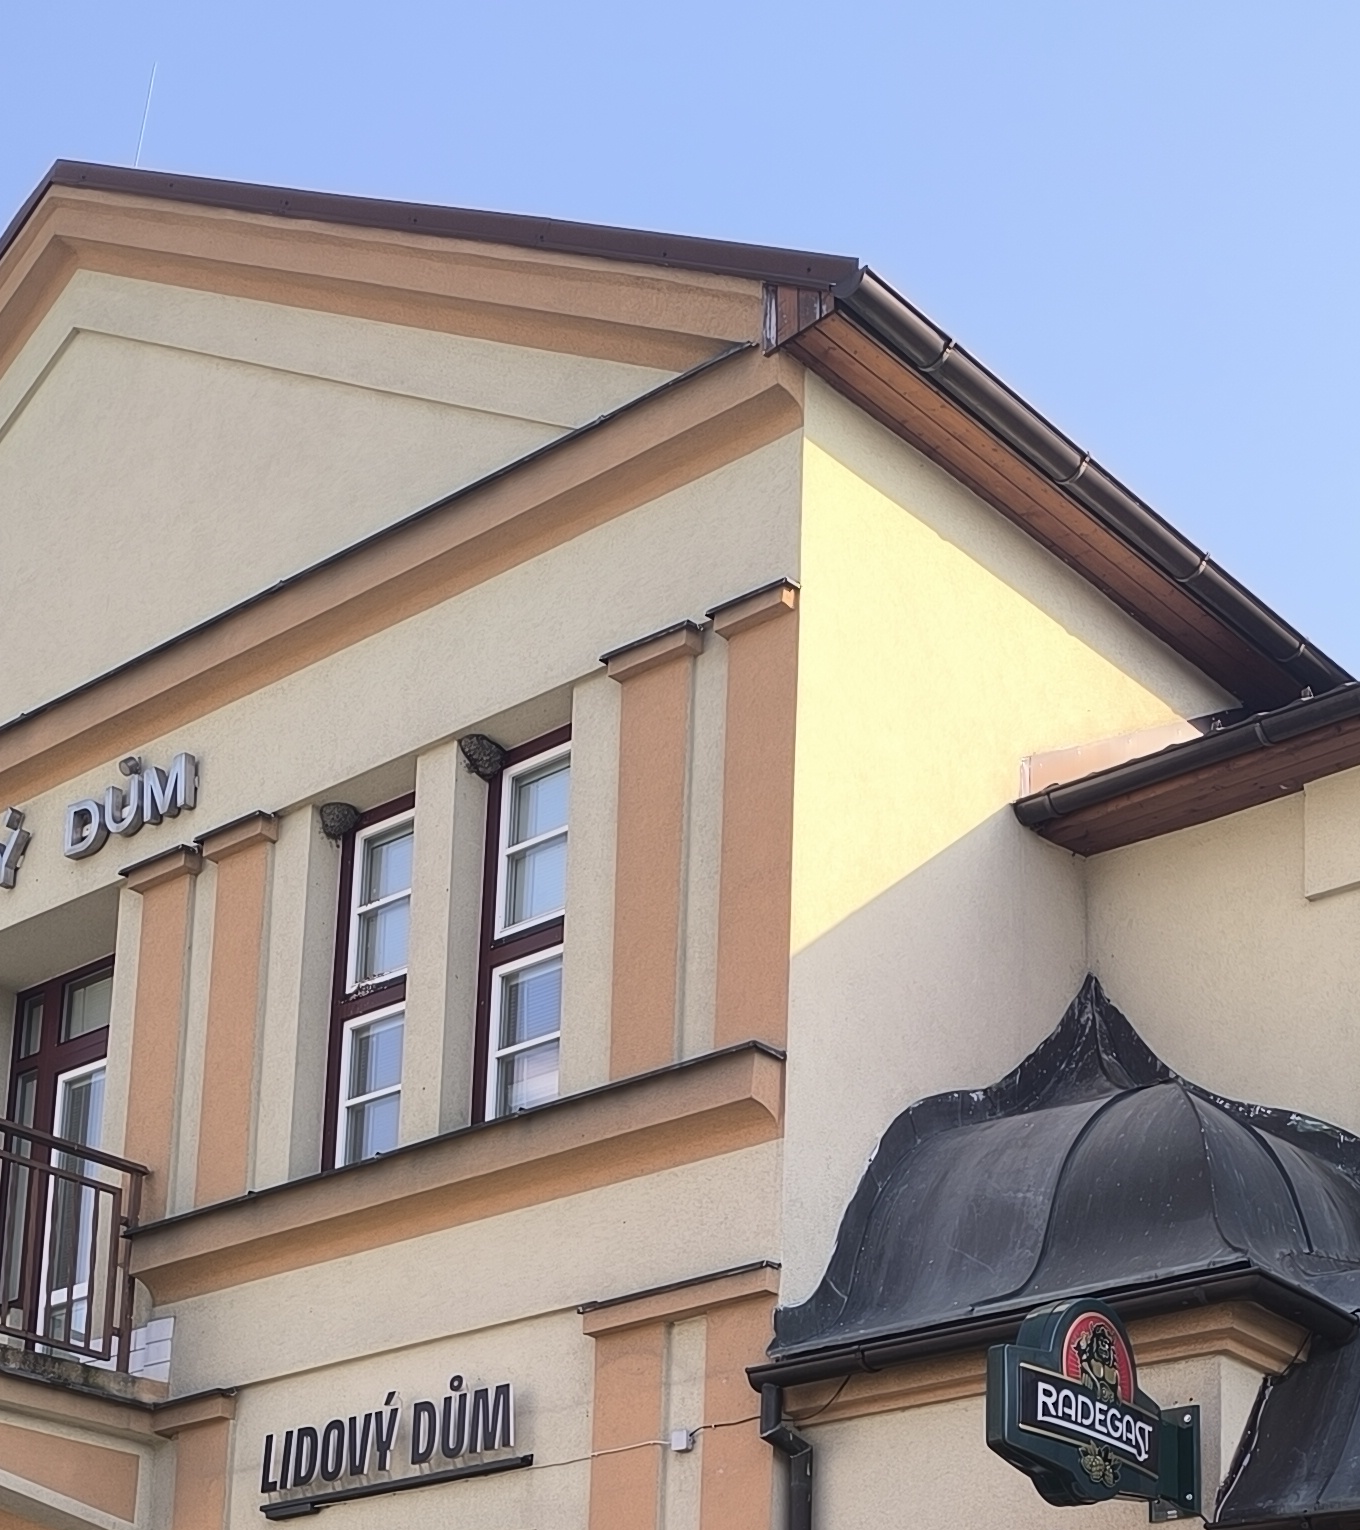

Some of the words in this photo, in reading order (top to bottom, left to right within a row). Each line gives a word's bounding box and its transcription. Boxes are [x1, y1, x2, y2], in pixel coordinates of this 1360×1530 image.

[64, 752, 198, 860] DŮM
[260, 1390, 401, 1494] LIDOVÝ
[410, 1374, 515, 1465] DŮM
[1037, 1381, 1153, 1461] RADEGAST
